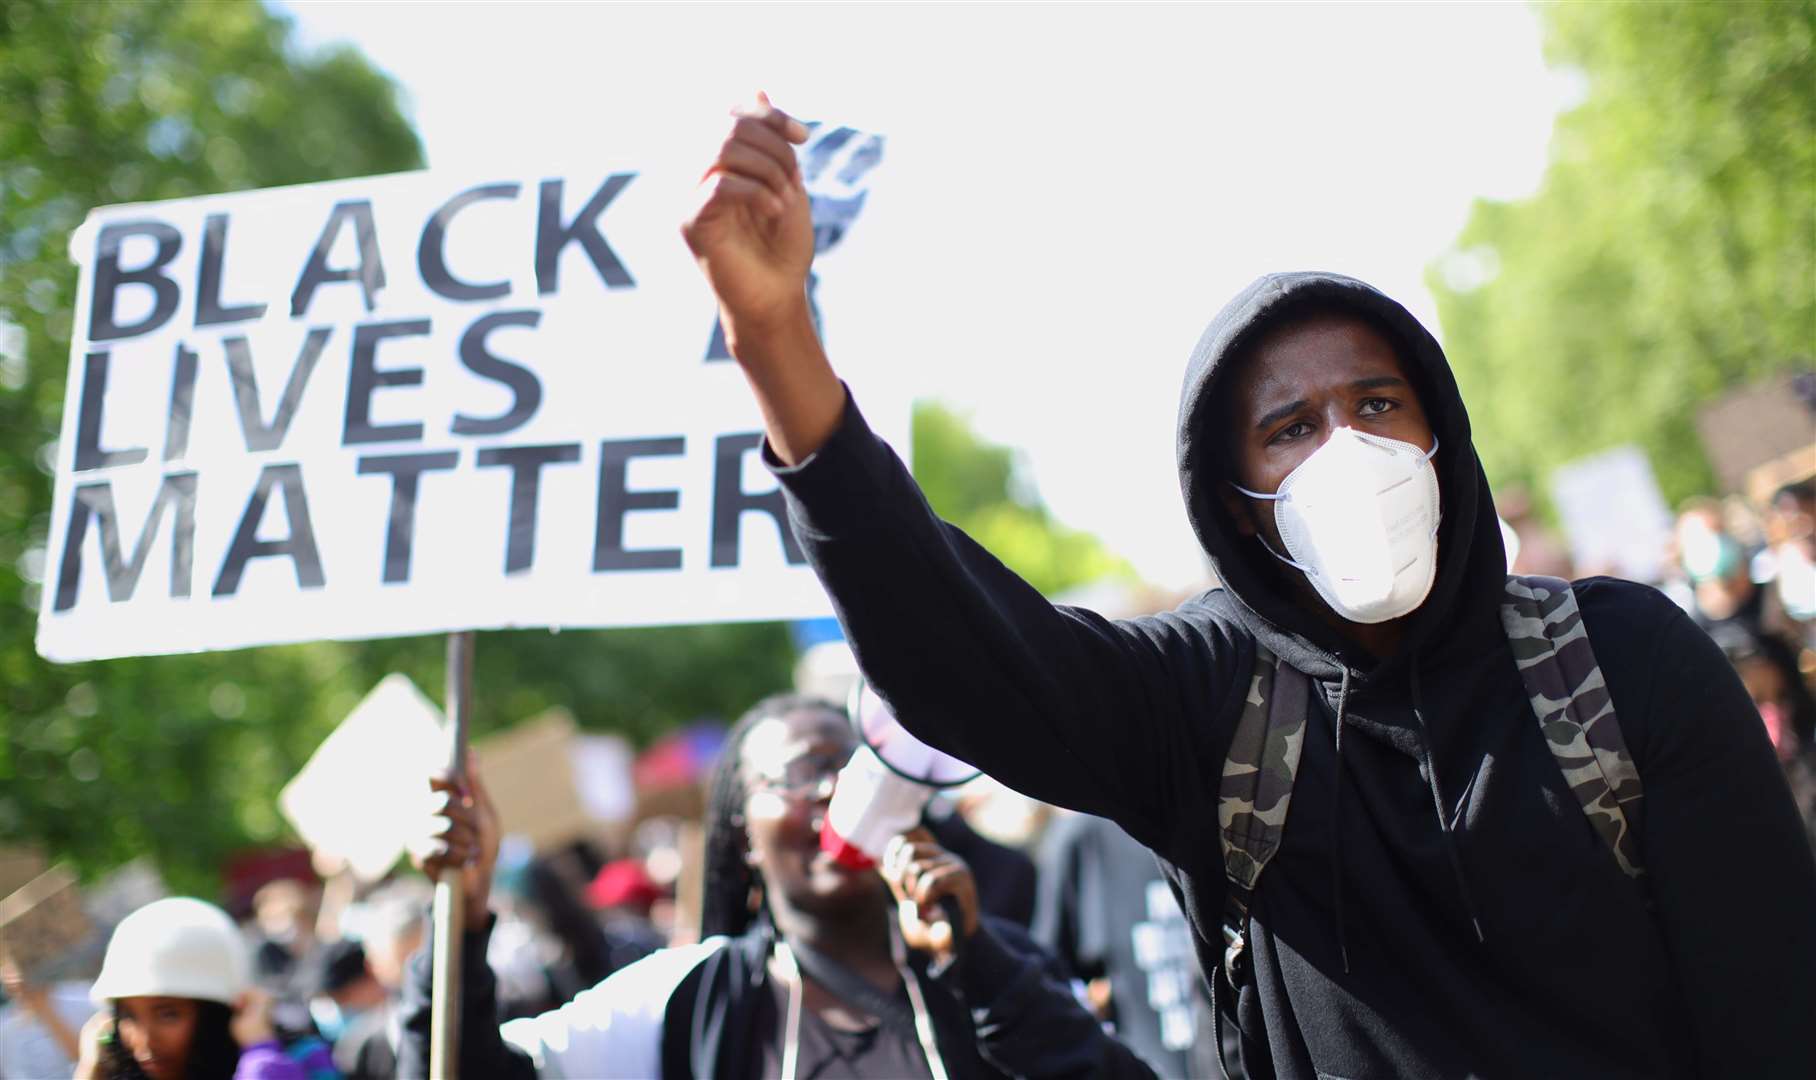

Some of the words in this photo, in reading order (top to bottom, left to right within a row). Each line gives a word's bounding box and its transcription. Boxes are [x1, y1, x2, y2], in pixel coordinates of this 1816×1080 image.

[87, 172, 638, 342] BLACK
[73, 309, 544, 473] LIVES
[53, 430, 808, 613] MATTER
